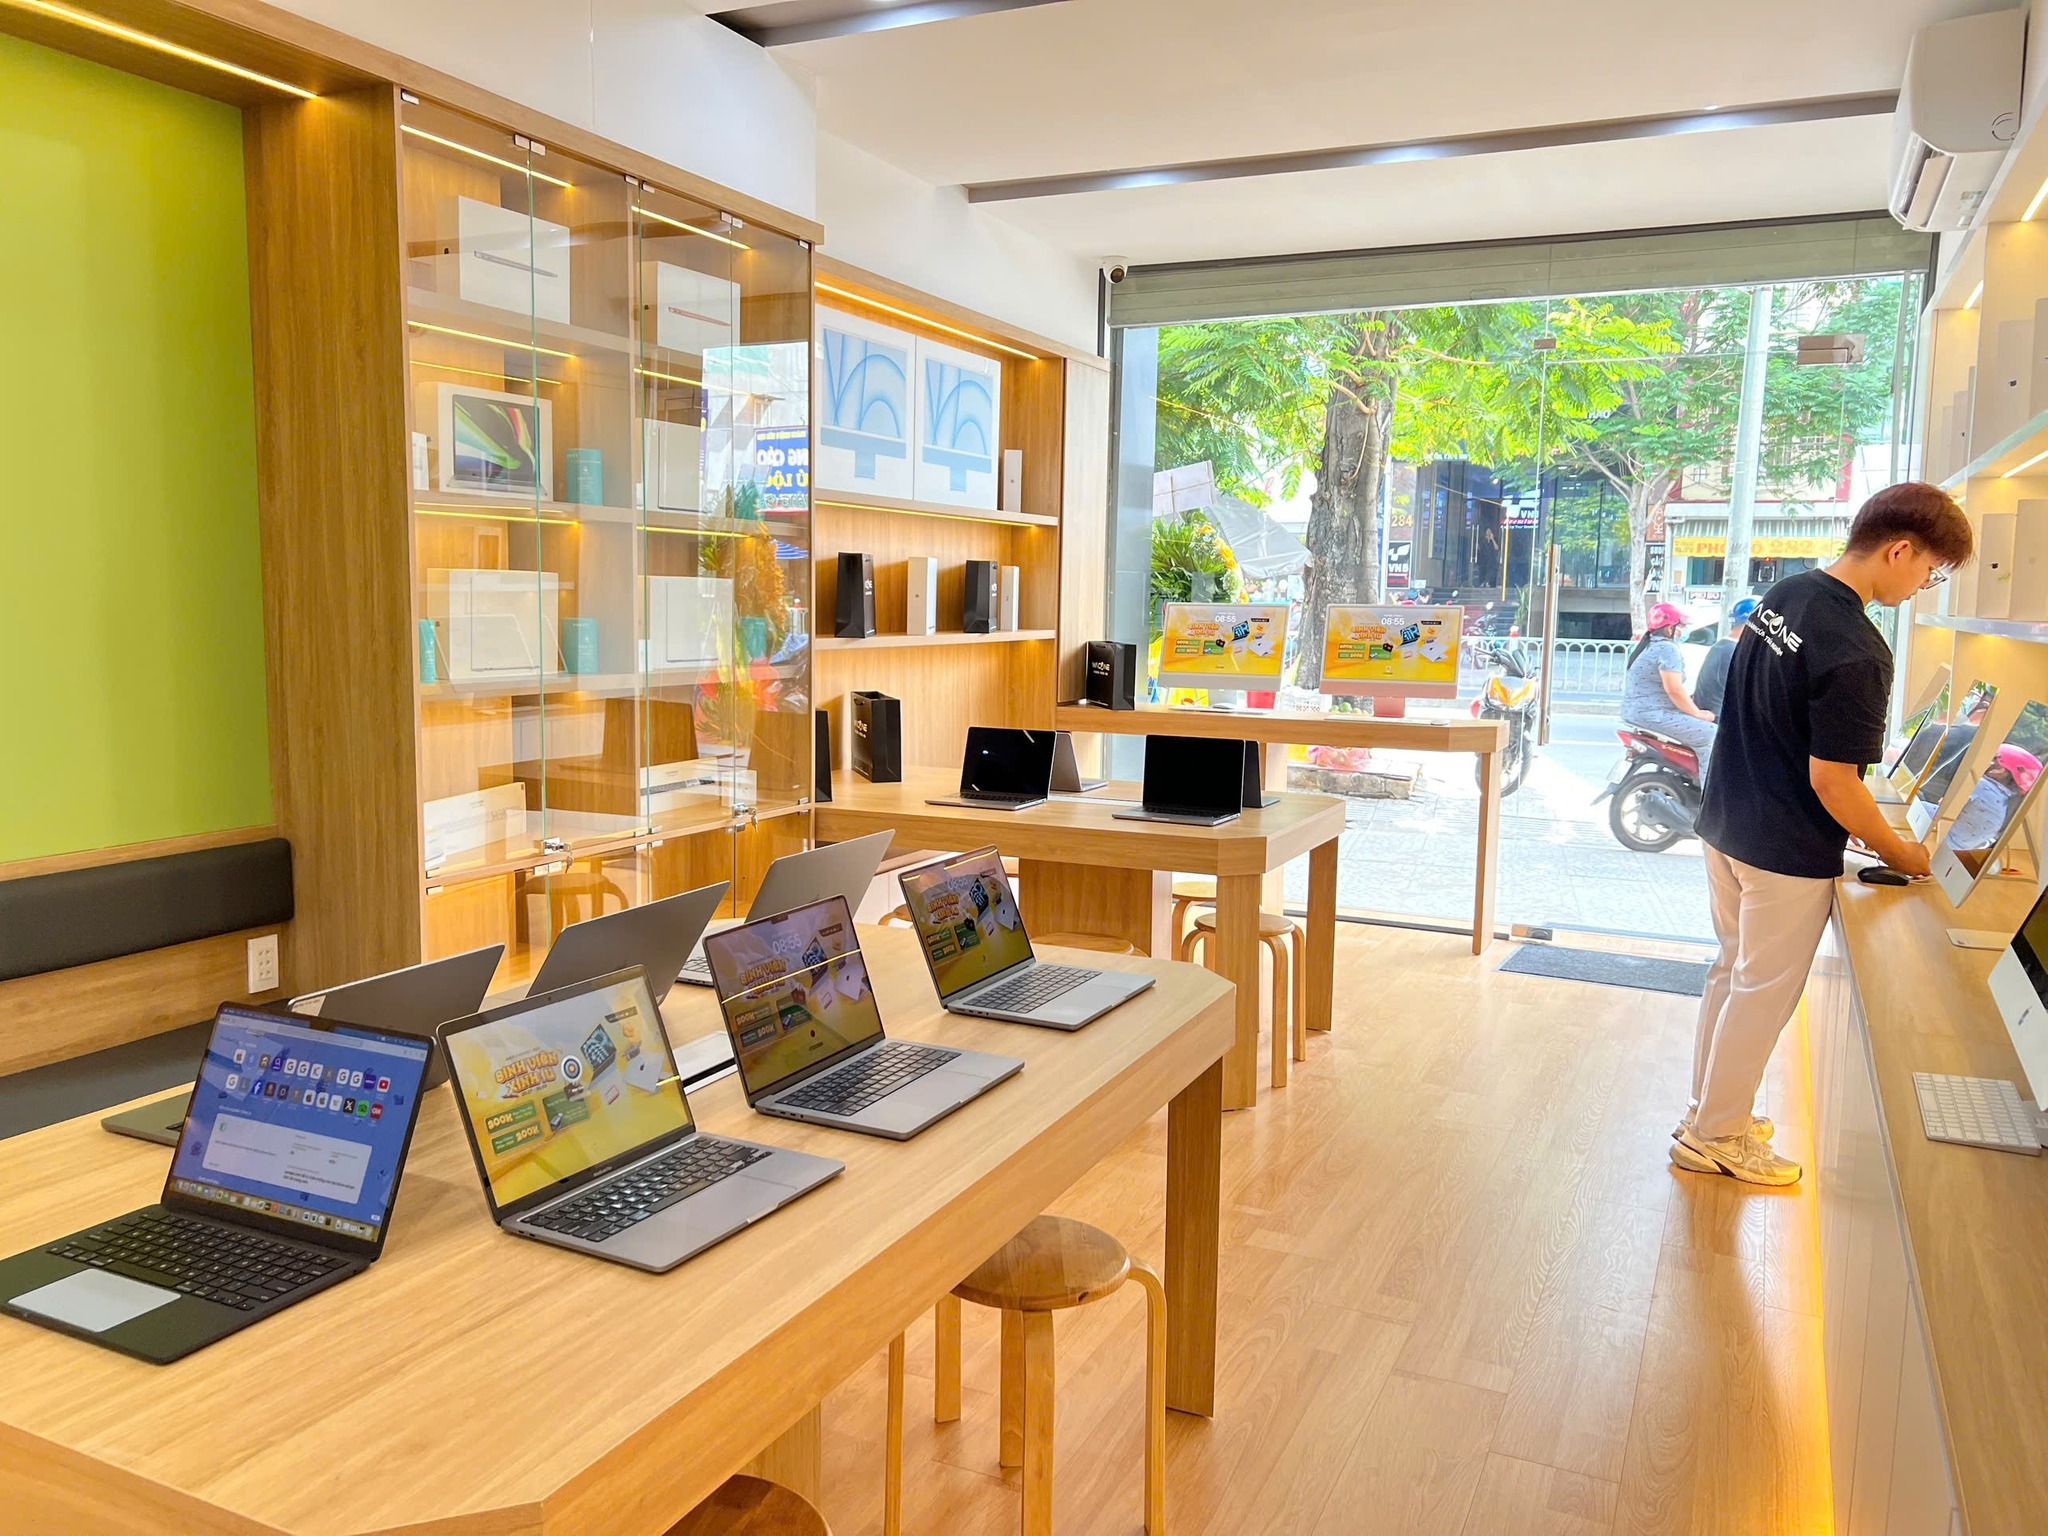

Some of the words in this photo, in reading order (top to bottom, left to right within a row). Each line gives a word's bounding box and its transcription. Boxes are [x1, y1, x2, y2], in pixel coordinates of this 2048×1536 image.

[1391, 514, 1413, 527] 284
[1389, 563, 1409, 573] VNB
[1381, 617, 1405, 625] 08:55
[772, 933, 803, 955] 08:55
[495, 1060, 527, 1084] SINH
[508, 1072, 541, 1092] XINH
